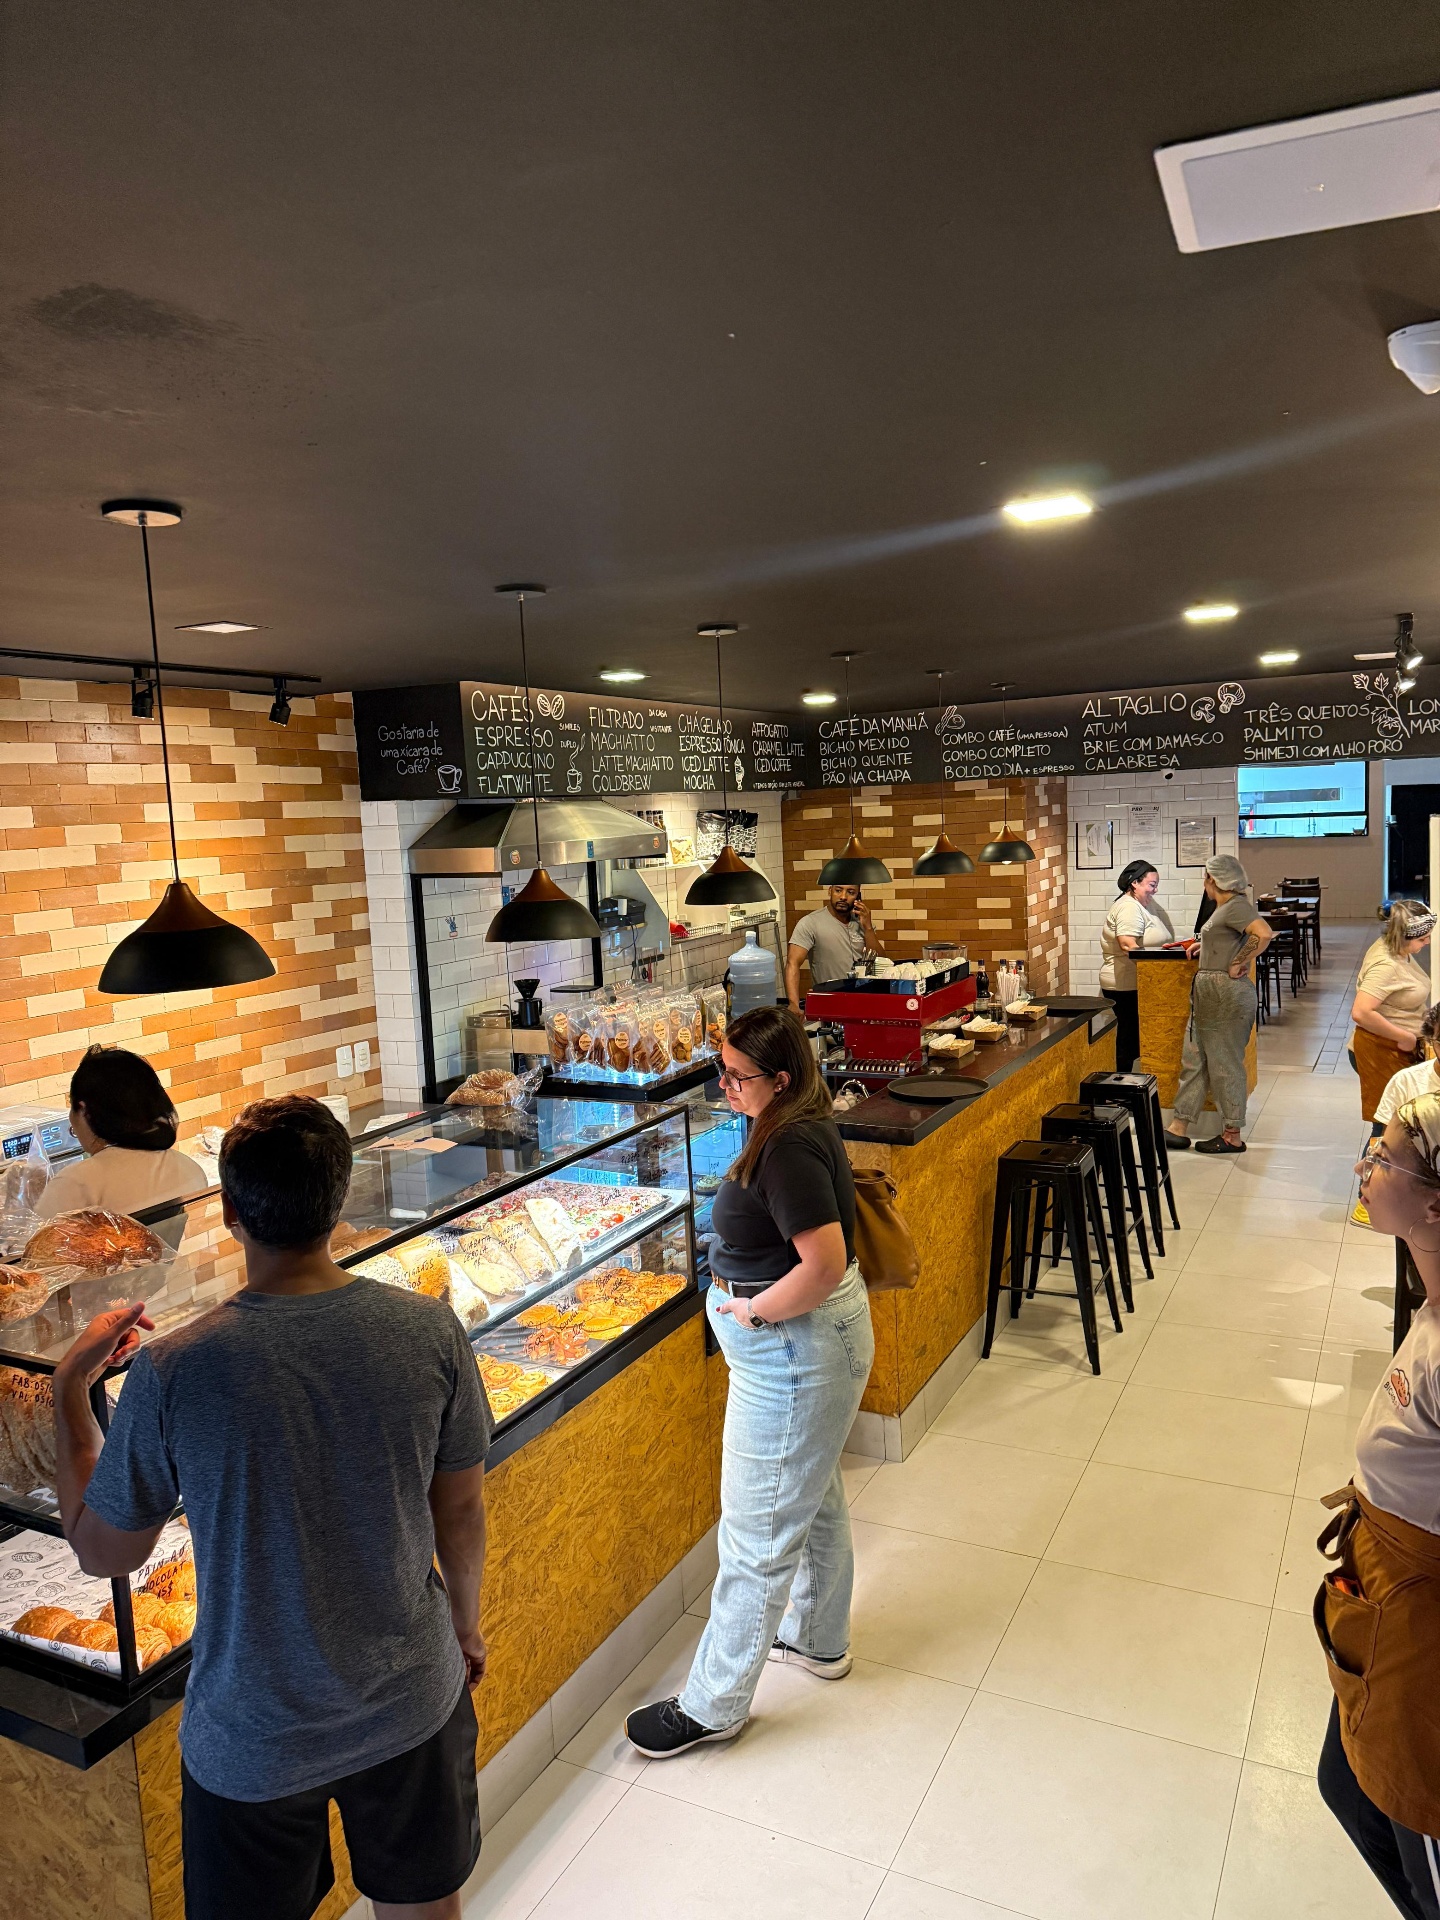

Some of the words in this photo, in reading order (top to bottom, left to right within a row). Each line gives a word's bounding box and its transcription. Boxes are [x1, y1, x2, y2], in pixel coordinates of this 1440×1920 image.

[471, 686, 534, 722] CAFÉS
[1082, 698, 1111, 719] AL
[1109, 692, 1187, 717] TAGLIO
[1244, 702, 1293, 724] TRÊS
[1297, 703, 1370, 721] QUEIJOS
[559, 723, 580, 731] SIMPLES
[589, 707, 643, 729] FILTRADO
[678, 711, 700, 733] CHÁ
[819, 714, 860, 738] CAFÉ
[862, 718, 880, 734] DA
[882, 712, 928, 733] MANHÃ
[378, 723, 424, 741] Gostaria
[427, 721, 439, 737] de
[474, 725, 553, 747] ESPRESSO
[943, 732, 985, 746] COMBO
[989, 724, 1015, 742] CAFÉ
[1084, 721, 1127, 737] ATUM
[1244, 725, 1323, 743] PALMITO
[381, 749, 399, 758] uma
[400, 745, 429, 757] xícara
[431, 740, 443, 755] de
[560, 740, 576, 748] DUPLO
[591, 732, 655, 751] MACHIATTO
[679, 736, 721, 753] ESPRESSO
[722, 735, 746, 754] TÔNICA
[753, 740, 785, 756] CARAMEL
[787, 742, 805, 757] LATTE
[820, 741, 855, 756] BICHO
[859, 737, 910, 752] MEXIDO
[1083, 740, 1119, 756] BRIE
[1123, 737, 1151, 751] COM
[1156, 732, 1224, 750] DAMASCO
[1244, 746, 1299, 761] SHIMEJI
[1303, 745, 1330, 757] COM
[1332, 740, 1366, 756] ALHO
[1368, 734, 1403, 755] PORÓ
[477, 751, 554, 770] CAPPUCCINO
[821, 756, 857, 771] BICHO
[862, 752, 913, 767] QUENTE
[943, 749, 987, 763] COMBO
[990, 744, 1051, 759] COMPLETO
[1086, 754, 1180, 772] CALABRESA
[397, 757, 430, 775] Café?
[592, 755, 624, 772] LATTE
[626, 756, 674, 771] MACHIATTO
[682, 755, 701, 772] ICED
[703, 756, 730, 772] LATTE
[755, 758, 770, 773] ICED
[944, 765, 982, 779] BOLO
[983, 765, 1001, 777] DO
[1002, 763, 1023, 776] DIA
[1033, 764, 1075, 775] ESPRESSO
[477, 773, 553, 794] FLATWHTE
[593, 775, 651, 793] COLDBREW
[683, 775, 715, 790] MOCHA
[823, 771, 846, 786] PÃO
[849, 772, 866, 784] NA
[868, 770, 912, 783] CHAPA
